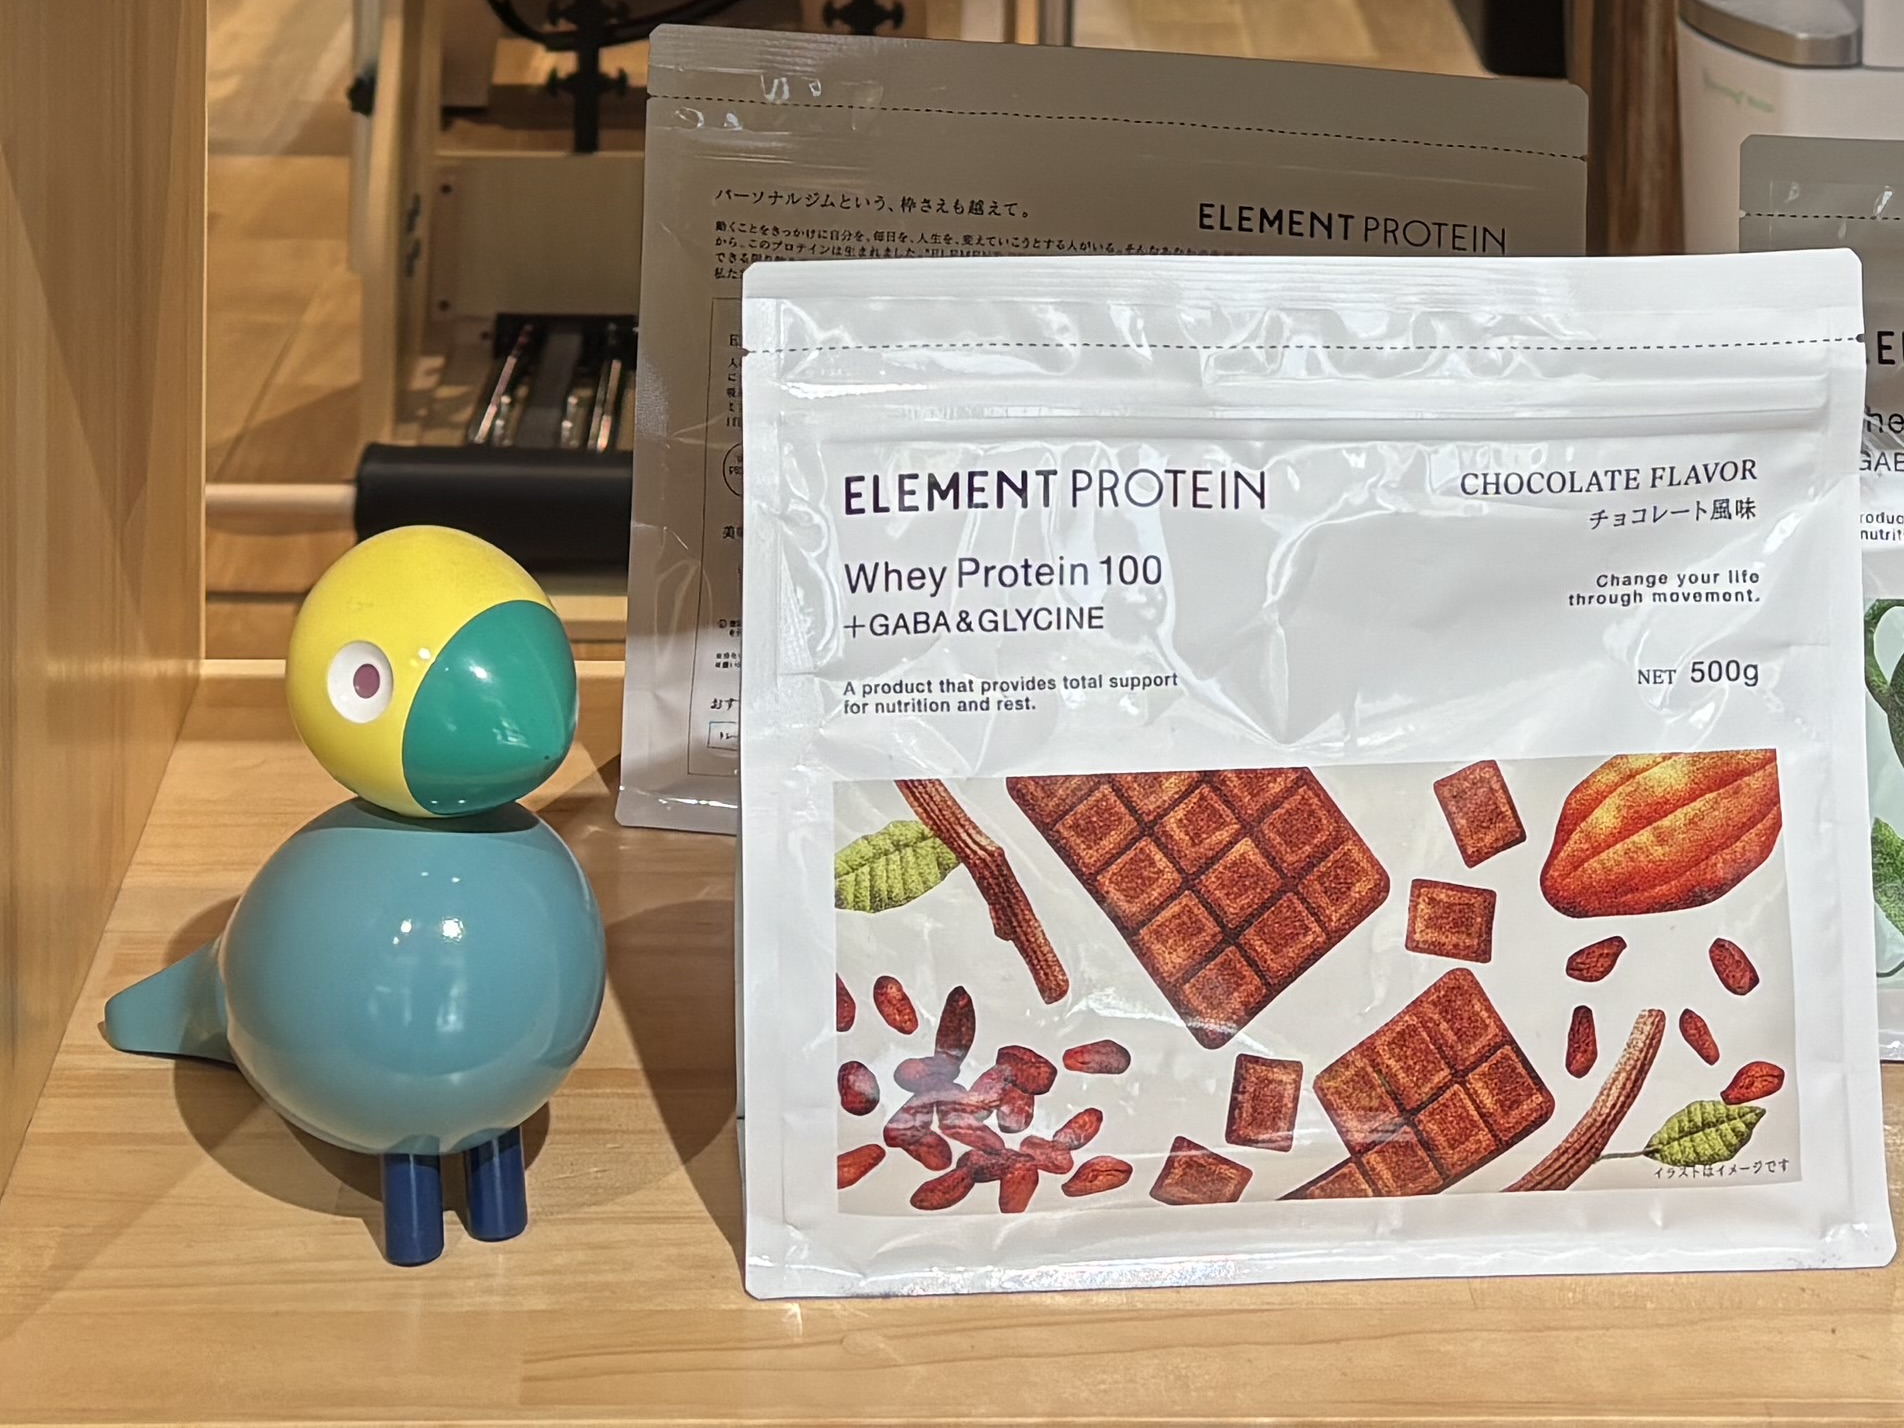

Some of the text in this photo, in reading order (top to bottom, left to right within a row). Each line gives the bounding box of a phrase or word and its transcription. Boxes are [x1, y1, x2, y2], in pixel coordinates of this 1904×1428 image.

[1198, 202, 1506, 255] ELEMENT PROTEIN
[843, 468, 1267, 515] ELEMENT PROTEIN
[1460, 458, 1757, 496] CHOCOLATE FLAVOR
[1589, 497, 1757, 530] チョコレート風味
[844, 554, 1163, 597] Whey Protein 100
[1595, 568, 1760, 588] Change your life
[1568, 588, 1761, 607] through movement.
[843, 605, 1105, 639] +GABA&GLYCINE
[843, 672, 1178, 697] A product that provides total support
[1637, 659, 1760, 687] NET 500g
[843, 696, 1037, 714] for nutrition and rest.
[1654, 1158, 1790, 1179] イラストはイメージです
